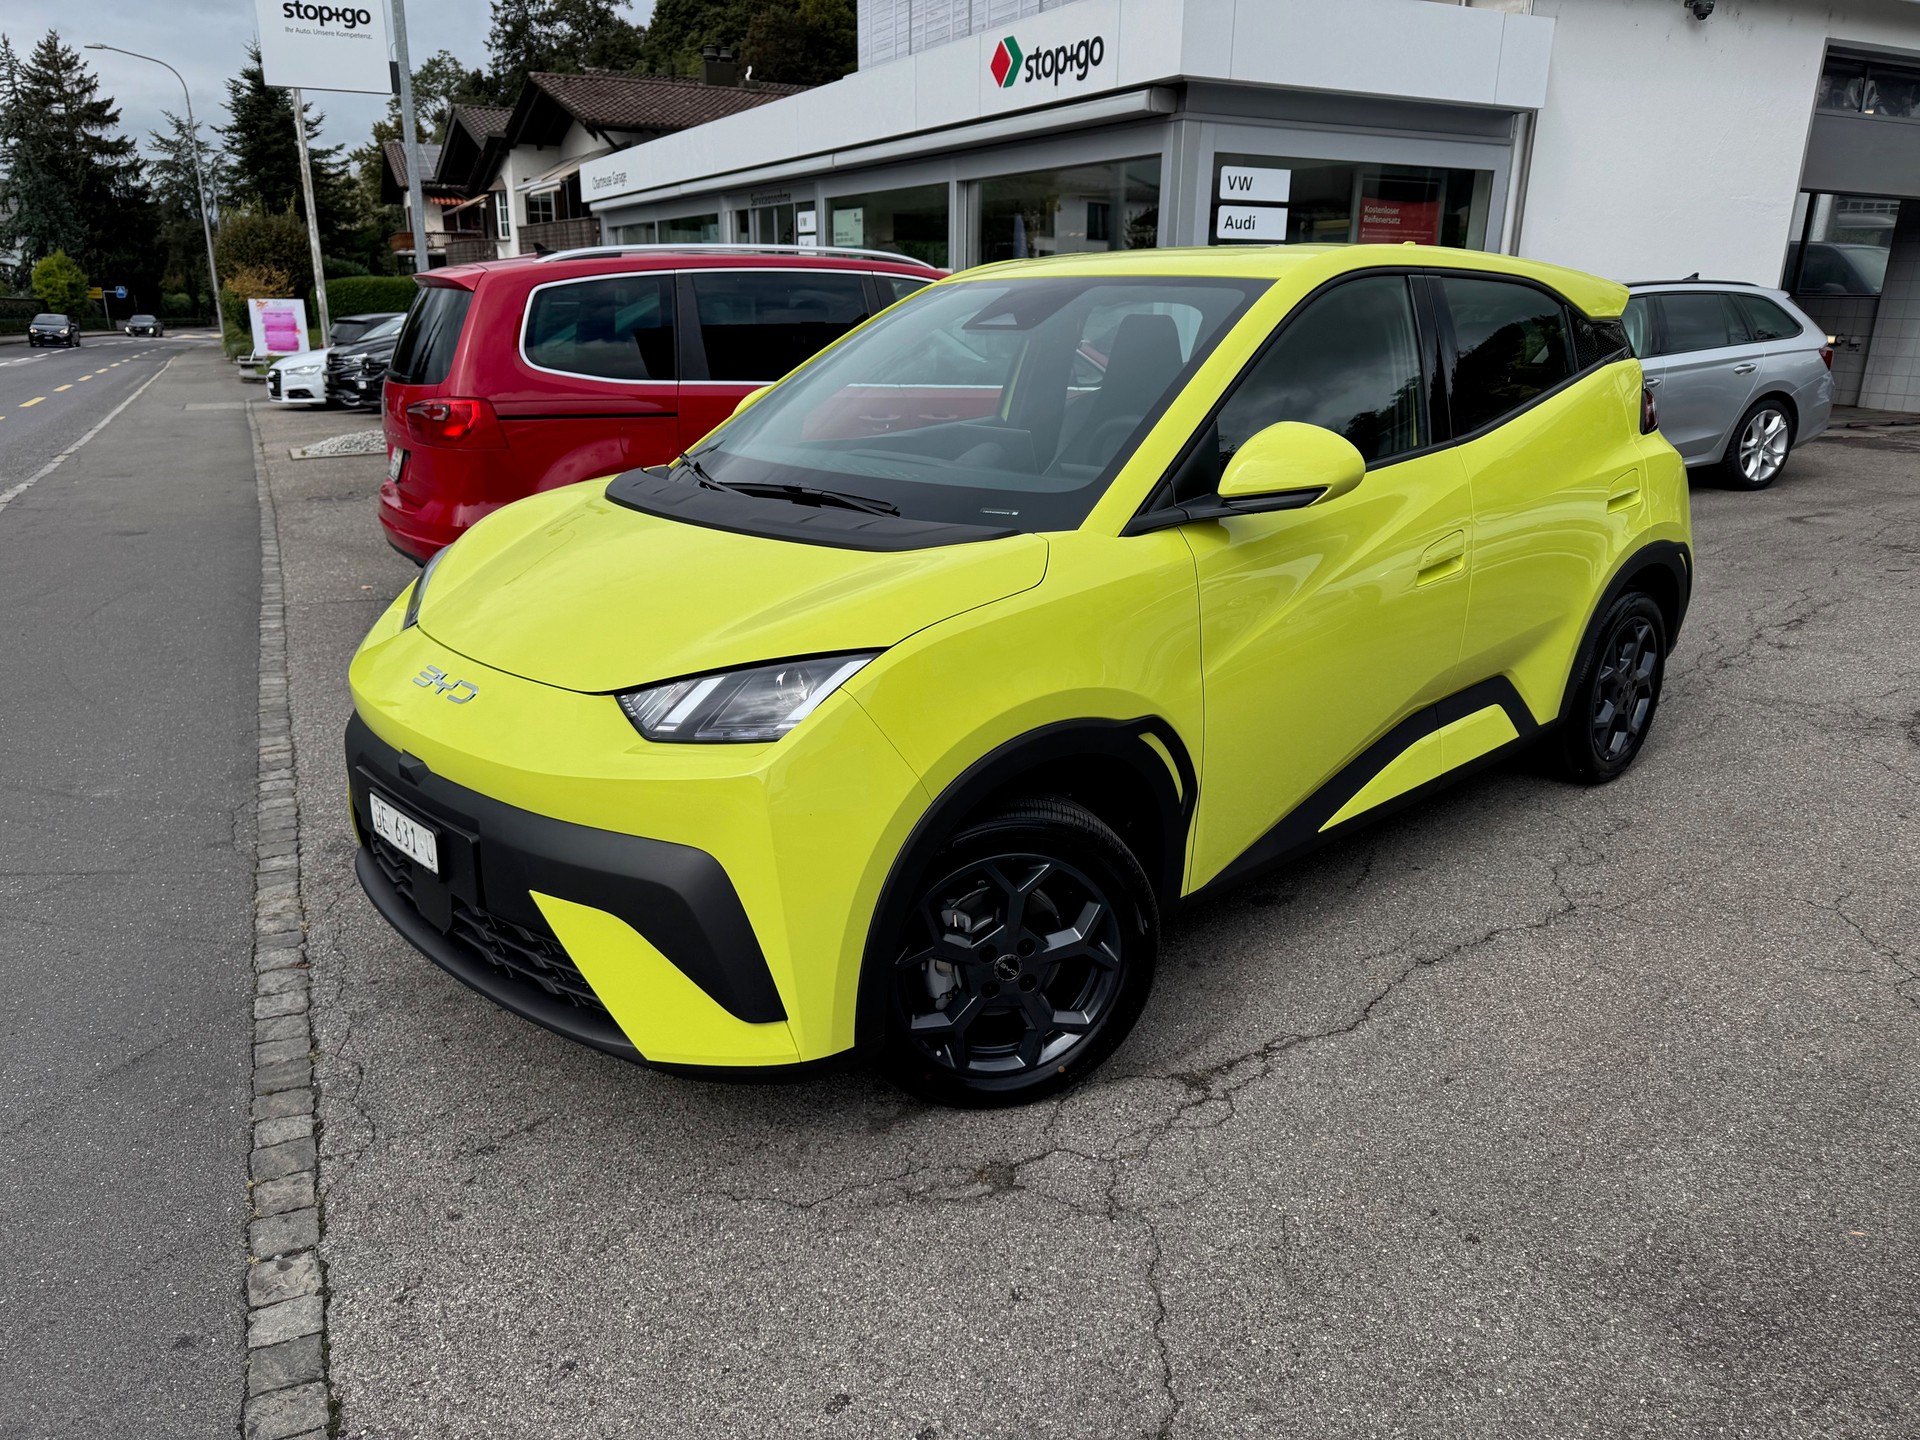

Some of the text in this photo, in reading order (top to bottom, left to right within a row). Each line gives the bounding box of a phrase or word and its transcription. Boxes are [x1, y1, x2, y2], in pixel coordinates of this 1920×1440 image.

[282, 0, 371, 29] stop+go
[295, 27, 311, 35] Auto.
[313, 29, 335, 37] Unsere
[1025, 36, 1104, 86] stop+go
[1228, 175, 1253, 191] VW
[1364, 205, 1400, 215] Kostenloser
[1224, 215, 1256, 230] Audi
[1363, 215, 1401, 225] Reifenersatz
[412, 664, 479, 704] BYD
[999, 962, 1018, 976] BYD
